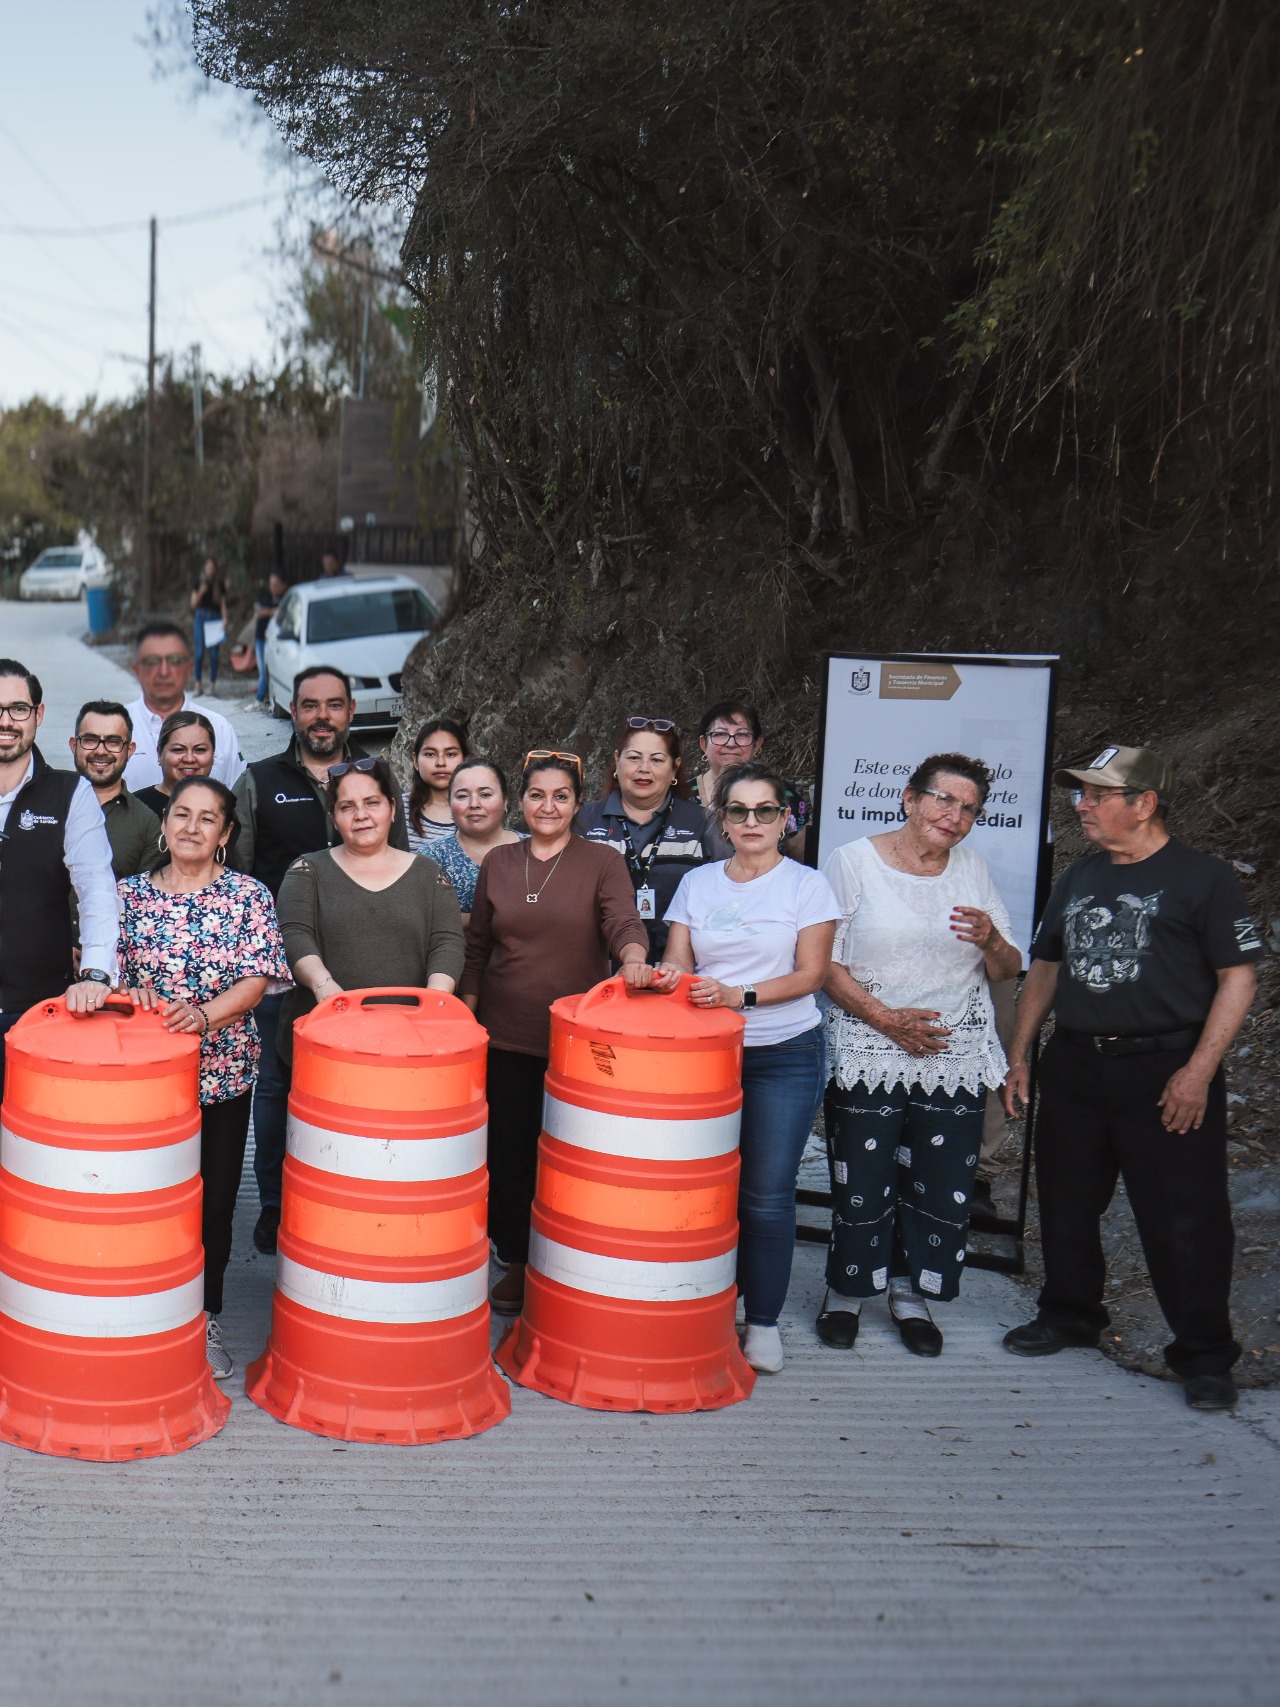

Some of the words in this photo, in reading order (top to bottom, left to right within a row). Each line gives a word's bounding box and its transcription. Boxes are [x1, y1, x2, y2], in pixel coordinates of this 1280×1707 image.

[853, 758, 889, 775] Este
[892, 764, 911, 776] es
[844, 781, 866, 798] de
[868, 781, 903, 799] don
[837, 806, 855, 820] tu
[976, 813, 1023, 829] edial
